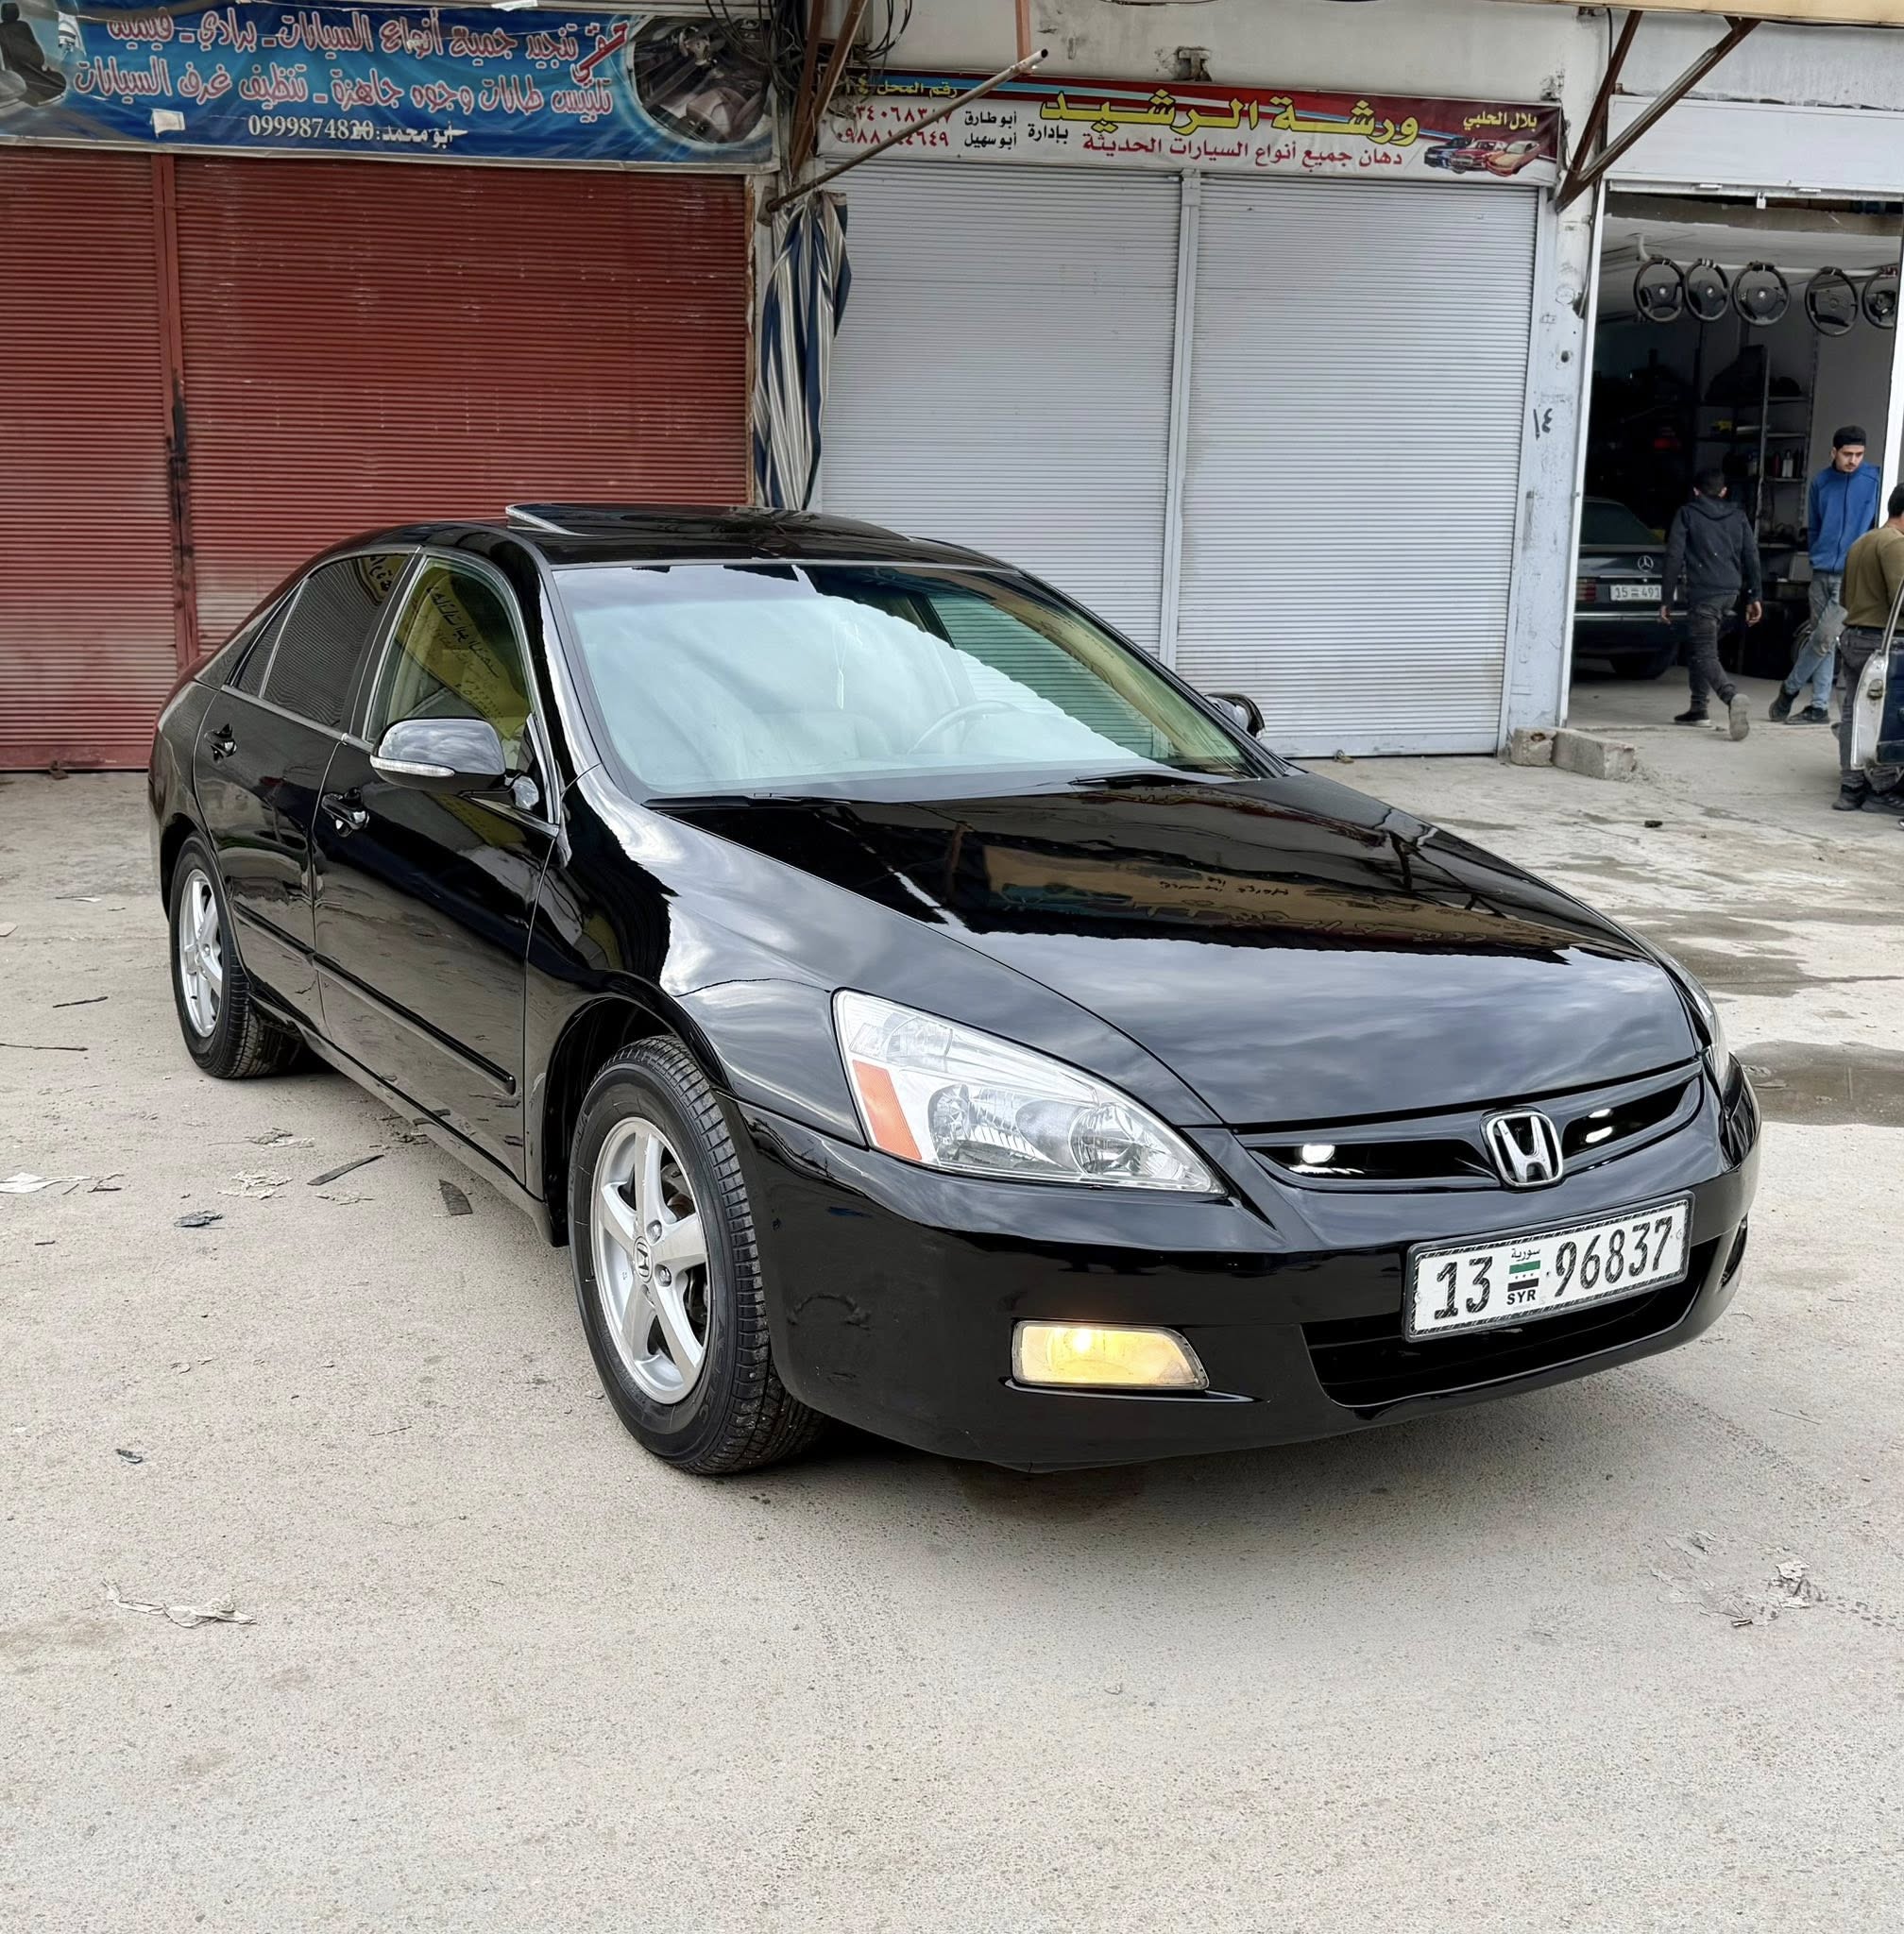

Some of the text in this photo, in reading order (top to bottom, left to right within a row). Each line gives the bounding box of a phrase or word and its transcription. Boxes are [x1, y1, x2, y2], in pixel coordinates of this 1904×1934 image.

[197, 8, 257, 53] برادي
[278, 11, 374, 59] السيارات
[379, 8, 443, 59] أنواع
[449, 25, 518, 66] جميع
[525, 24, 579, 69] تنجيد
[74, 56, 173, 104] السيارات
[178, 61, 232, 105] غرف
[239, 61, 308, 110] تنظيف
[330, 67, 404, 111] جاهزة
[411, 79, 473, 115] وجوه
[551, 77, 613, 123] تلبيس
[876, 79, 924, 95] المحل
[929, 81, 958, 99] رقم
[964, 110, 1017, 129] أبو طارق
[1028, 122, 1069, 145] بإدارة
[1039, 88, 1420, 147] ورشة الرشيد
[1463, 110, 1538, 132] بلال الحلبي
[963, 131, 1017, 150] أبو سهيل
[1081, 131, 1402, 173] دهان جميع أنواع السيارات الحديثة
[1614, 586, 1628, 599] 15
[1434, 1214, 1674, 1320] 13 96837
[1510, 1247, 1541, 1262] سورية
[1506, 1290, 1537, 1306] SYR
